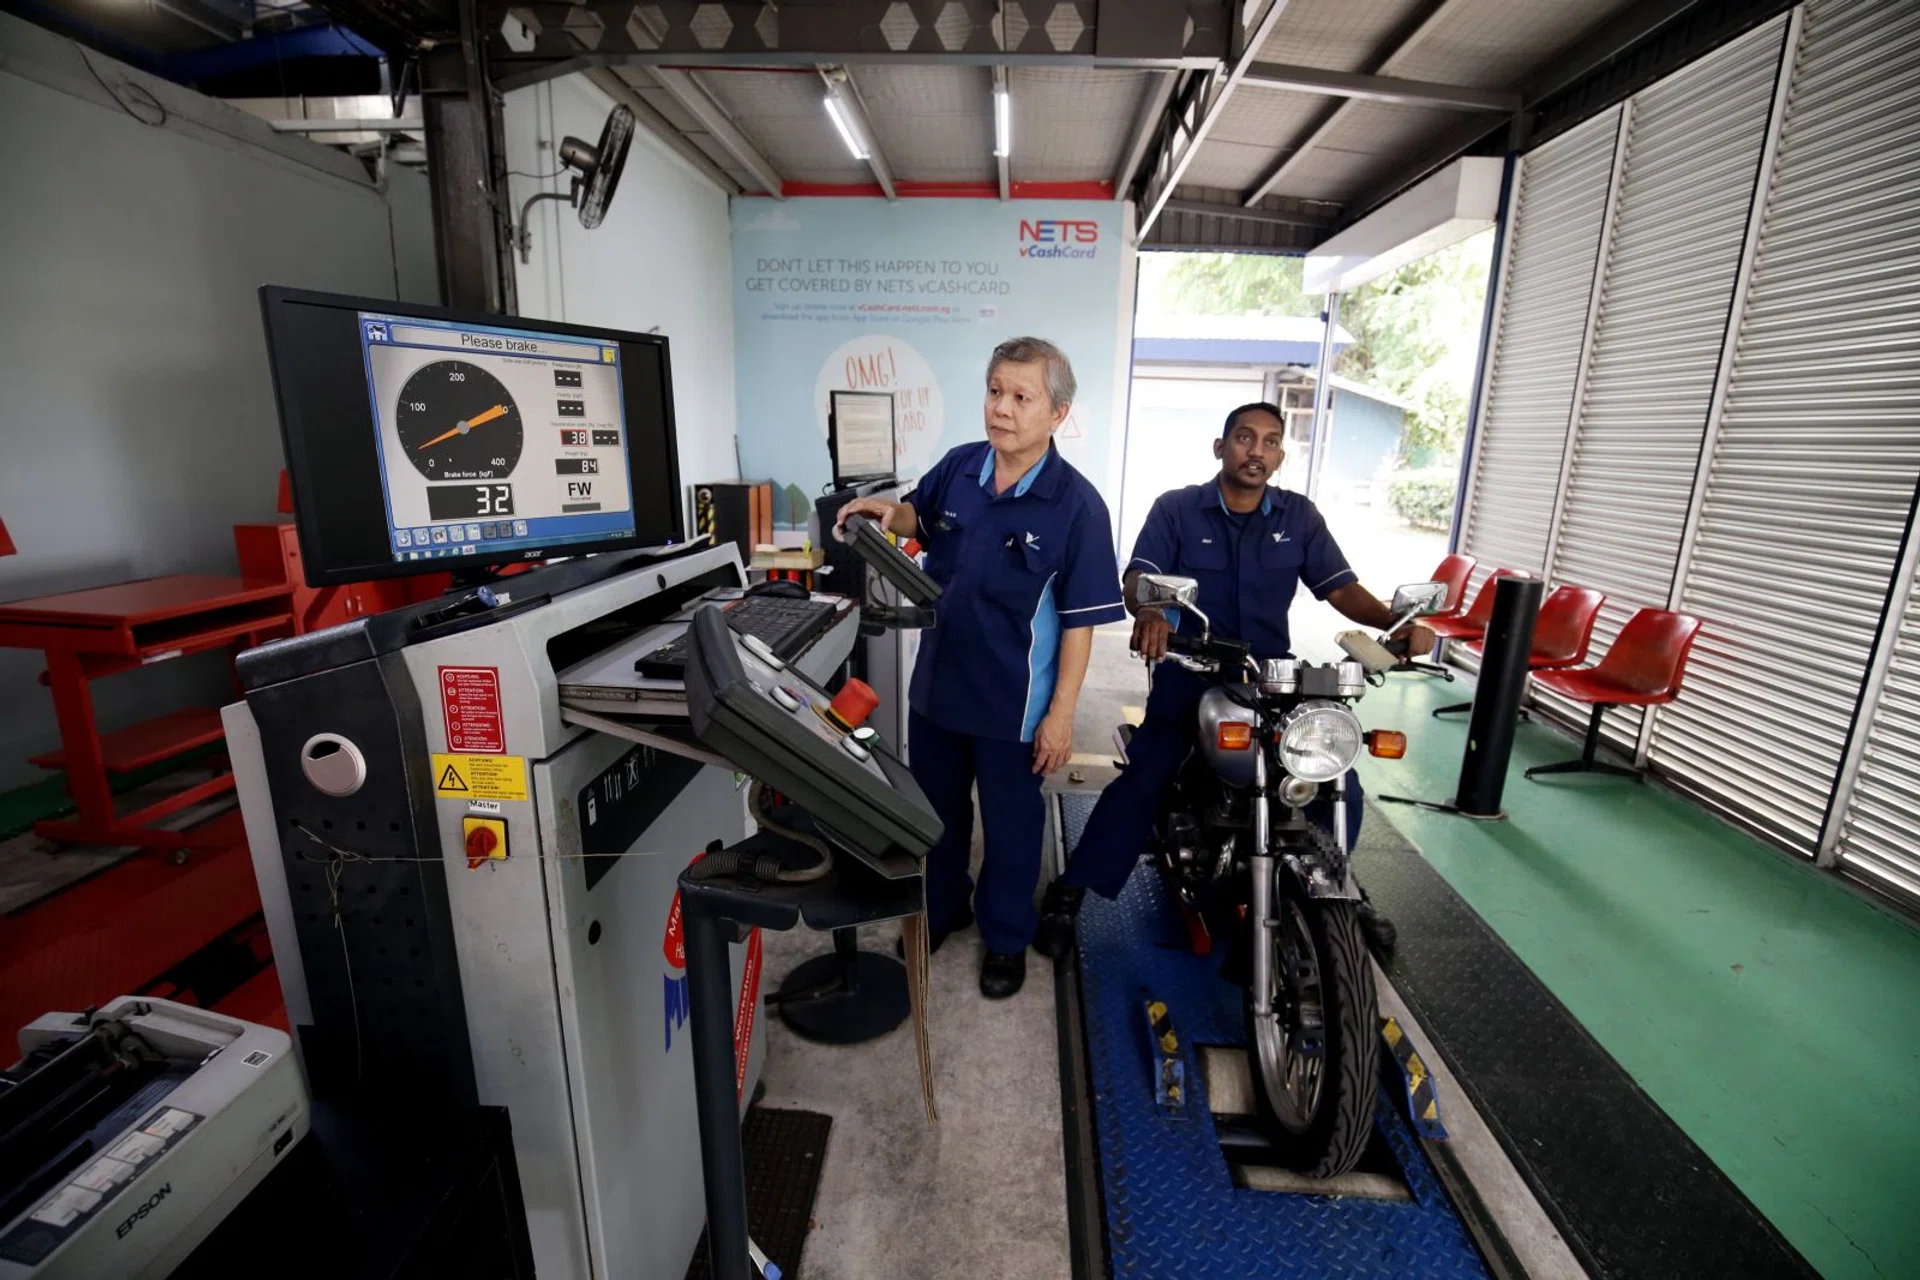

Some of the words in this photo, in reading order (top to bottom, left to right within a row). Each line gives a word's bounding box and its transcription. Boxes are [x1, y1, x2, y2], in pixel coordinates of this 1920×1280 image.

[1019, 219, 1098, 242] NETS
[1019, 245, 1096, 259] vCashCard
[808, 259, 835, 273] LET
[838, 259, 870, 273] THIS
[875, 260, 936, 274] HAPPEN
[940, 260, 961, 275] TO
[745, 277, 774, 291] GET
[779, 277, 850, 292] COVERED
[855, 278, 872, 292] BY
[877, 279, 914, 293] NETS
[461, 333, 503, 351] Please
[845, 345, 898, 390] OMG!
[449, 373, 465, 382] 200
[409, 403, 426, 412] 100
[571, 431, 586, 445] 38
[428, 458, 435, 468] 0
[490, 457, 506, 467] 400
[581, 460, 597, 473] 84
[567, 482, 592, 497] FW
[476, 486, 509, 515] 32
[470, 800, 498, 810] Master
[735, 959, 753, 1041] Workshop
[115, 1182, 173, 1240] EPSON
